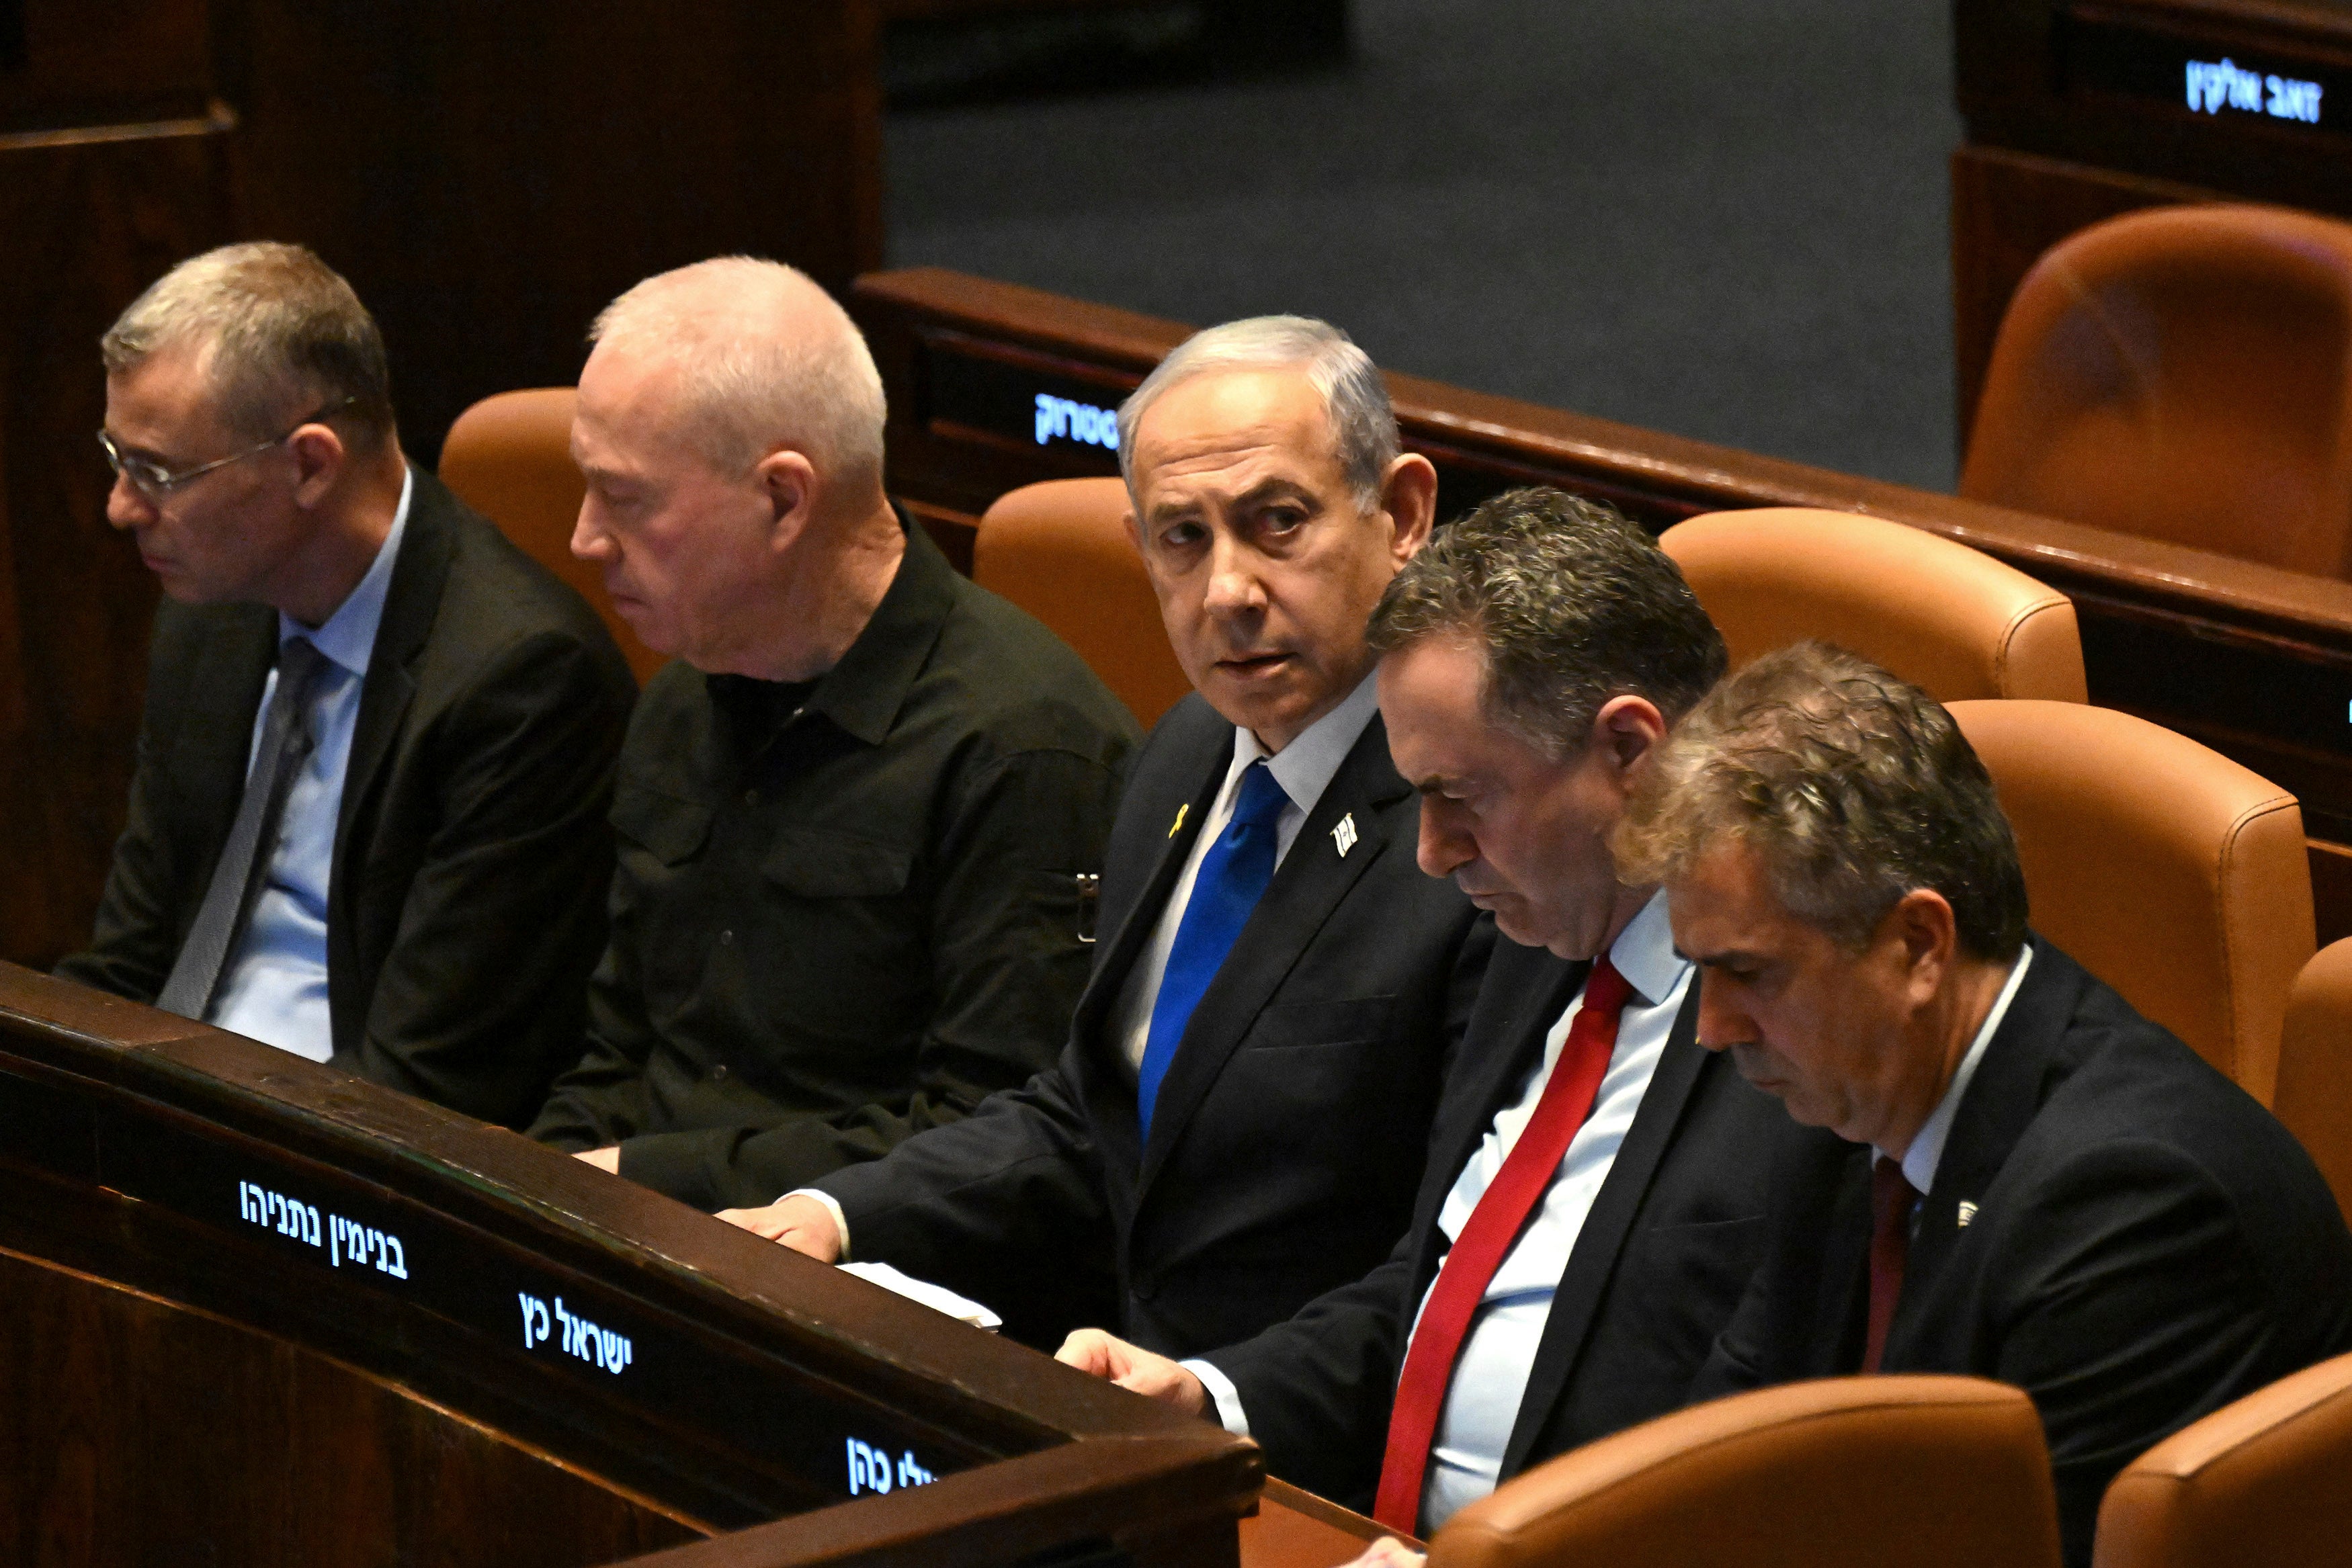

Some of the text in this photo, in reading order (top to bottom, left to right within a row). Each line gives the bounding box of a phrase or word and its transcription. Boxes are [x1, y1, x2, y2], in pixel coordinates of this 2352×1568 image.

[2186, 58, 2322, 124] זאב אלקין
[239, 1180, 408, 1279] בנימין נתניהו
[518, 1292, 633, 1375] ישראל כץ
[846, 1438, 938, 1496] לי כהן
